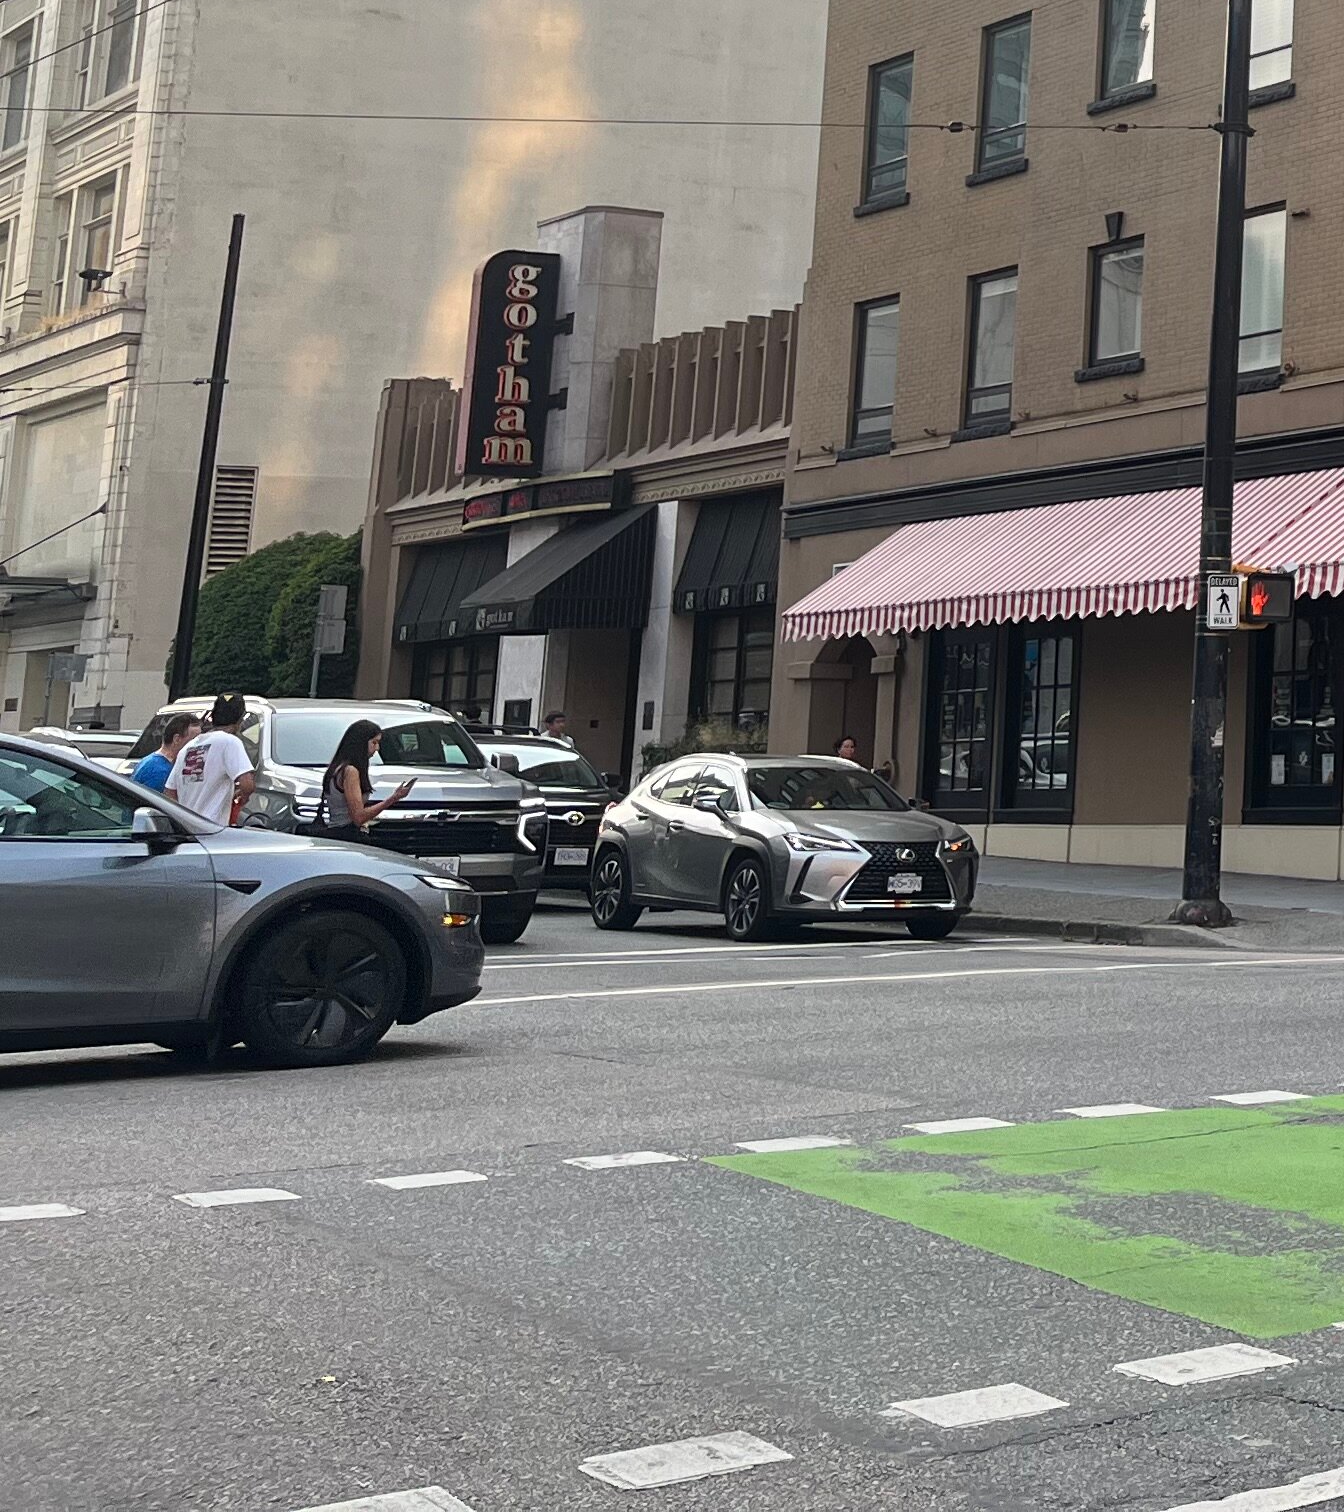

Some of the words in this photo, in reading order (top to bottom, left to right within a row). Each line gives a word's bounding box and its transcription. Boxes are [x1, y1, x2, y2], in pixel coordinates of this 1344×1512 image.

[482, 264, 543, 465] gotham
[1210, 577, 1238, 586] DELAYED
[1213, 616, 1233, 625] WALK
